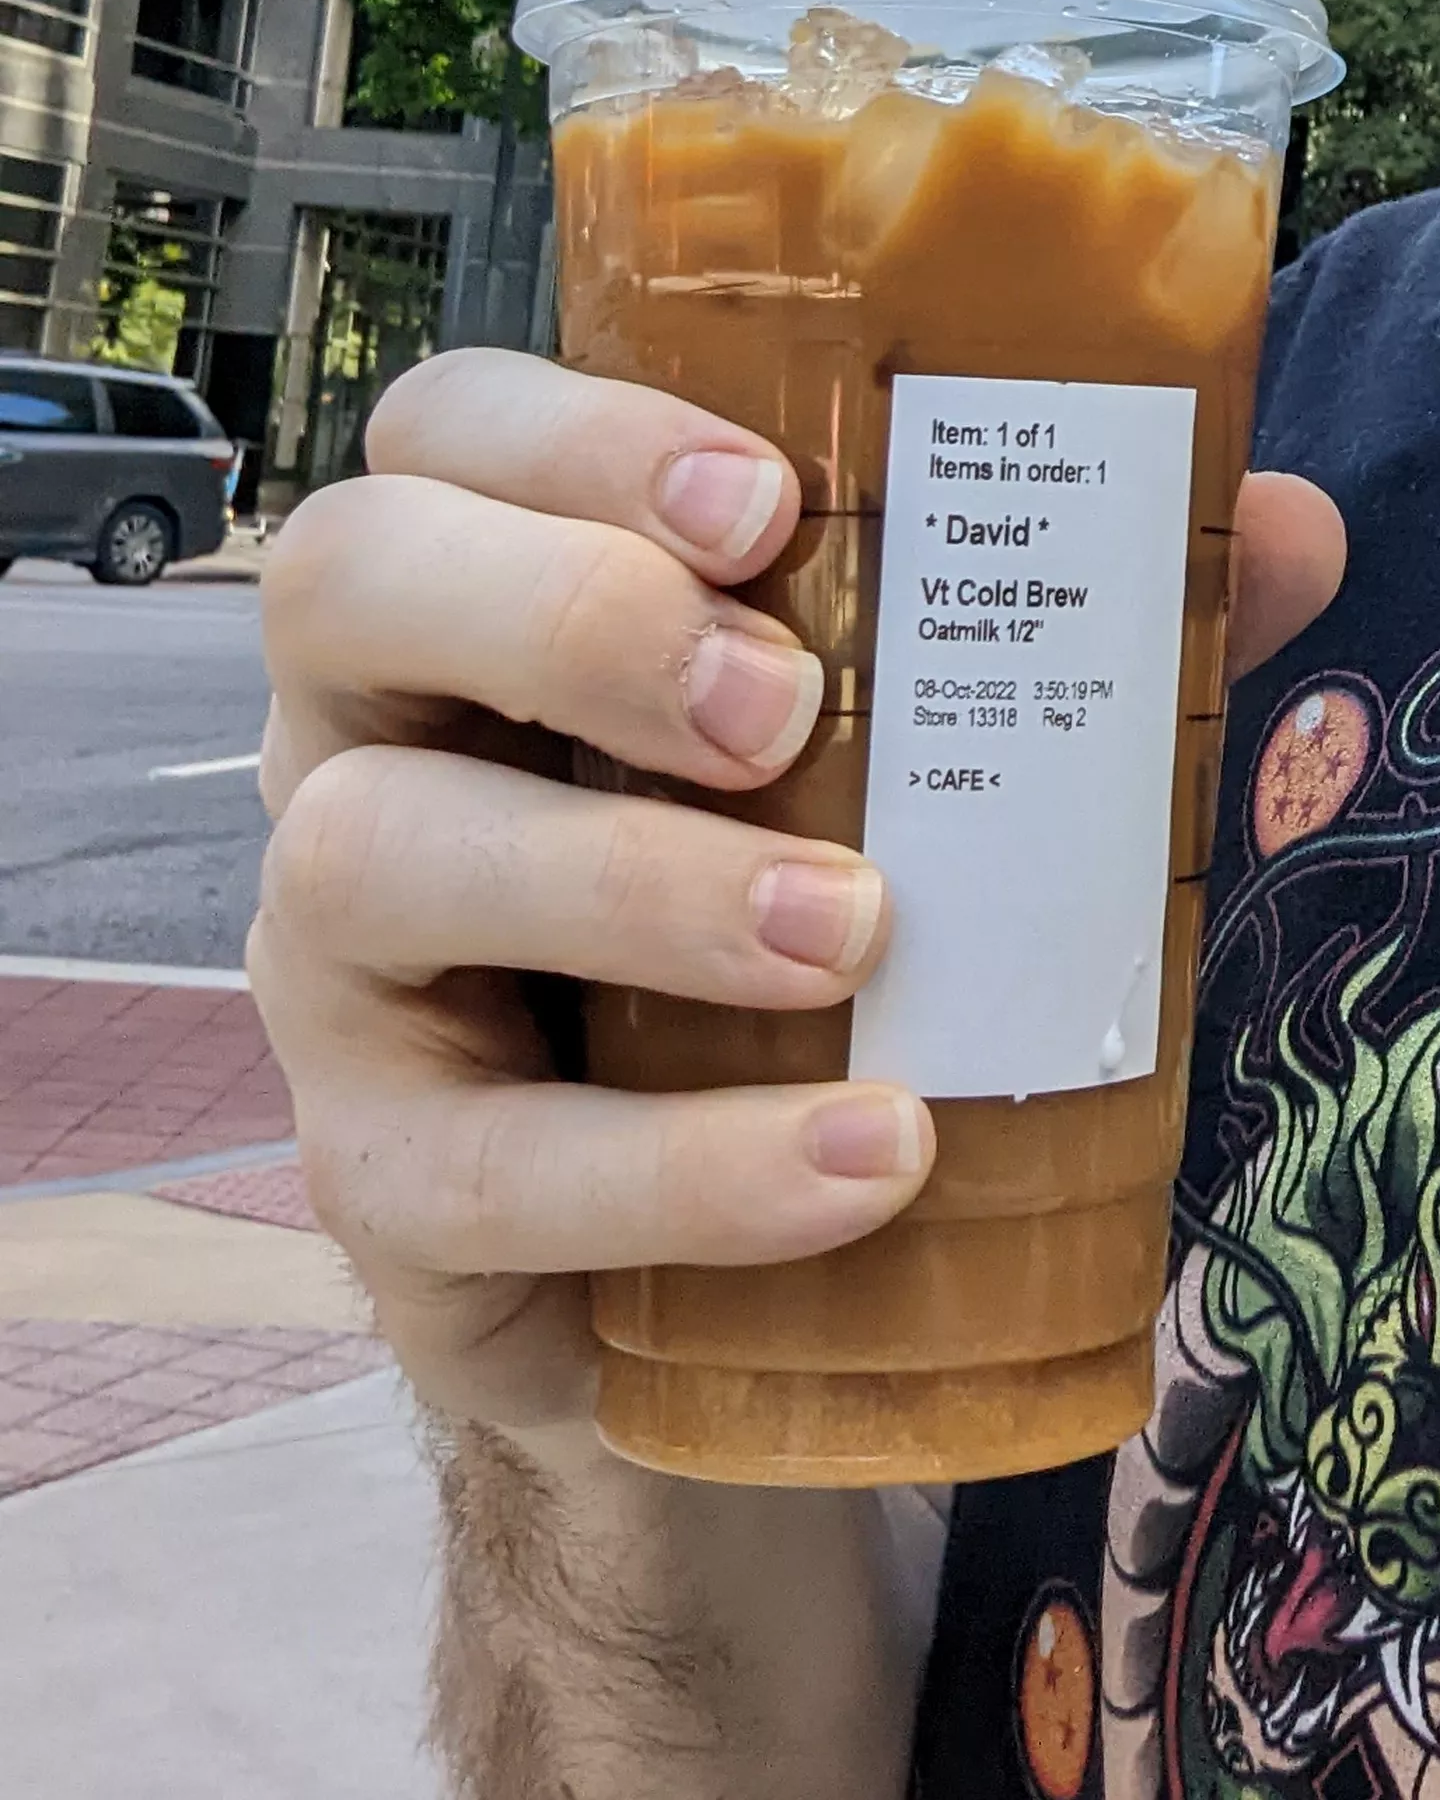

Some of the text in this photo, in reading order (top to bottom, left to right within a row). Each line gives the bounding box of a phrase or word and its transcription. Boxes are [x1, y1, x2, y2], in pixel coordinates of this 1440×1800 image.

[931, 417, 1056, 450] Item: 1 of 1
[929, 452, 1107, 485] Items in order: 1
[945, 513, 1031, 548] David
[920, 576, 1089, 609] Vt Cold Brew
[917, 616, 1001, 643] Oatmilk
[914, 678, 1017, 701] 08-Oct-2022
[1089, 679, 1114, 700] PM
[967, 706, 1018, 728] 13318
[1042, 706, 1073, 732] Reg
[1075, 706, 1087, 728] 2
[926, 767, 985, 792] CAFE
